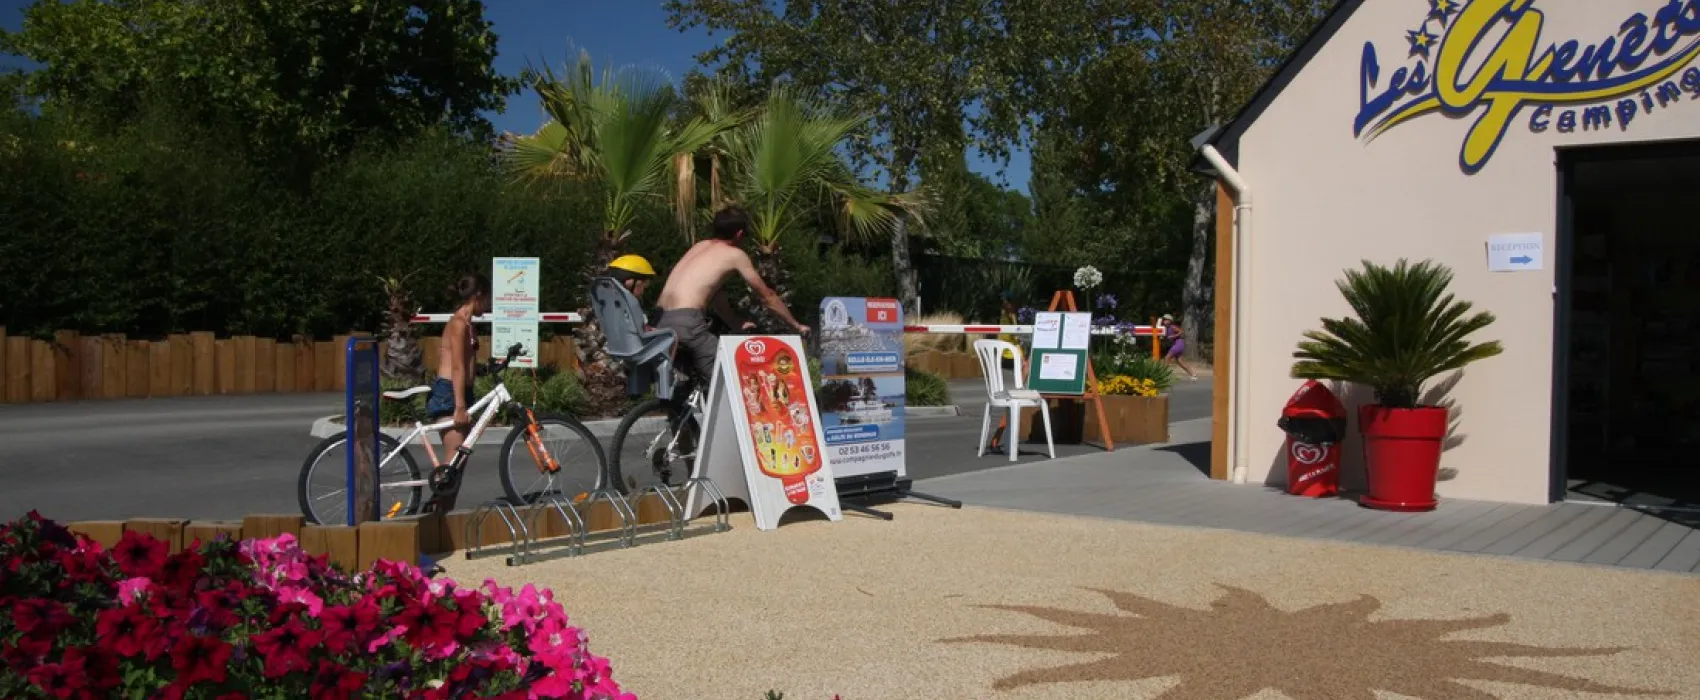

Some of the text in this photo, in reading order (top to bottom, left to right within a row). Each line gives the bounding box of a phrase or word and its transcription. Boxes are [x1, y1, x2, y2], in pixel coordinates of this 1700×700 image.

[1354, 41, 1430, 138] Les
[839, 442, 891, 456] 02 53 46 56 56
